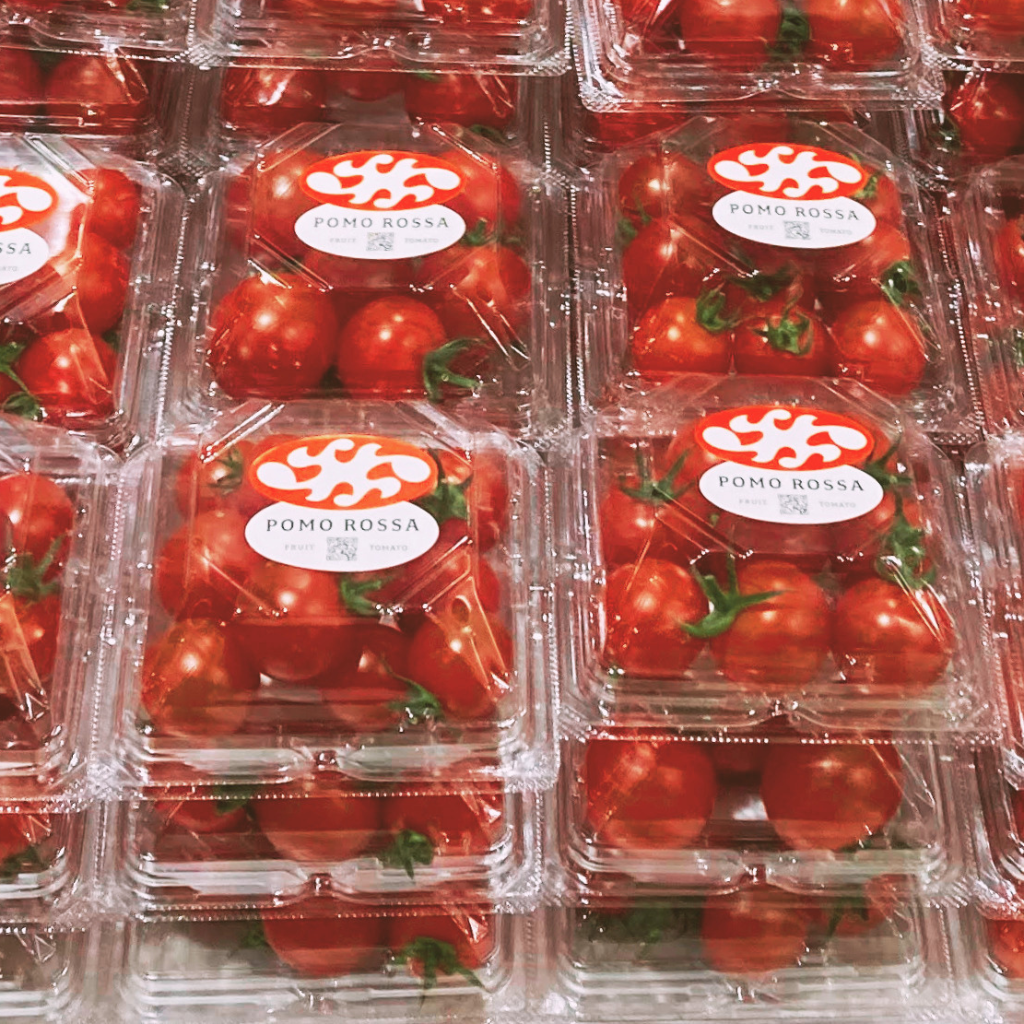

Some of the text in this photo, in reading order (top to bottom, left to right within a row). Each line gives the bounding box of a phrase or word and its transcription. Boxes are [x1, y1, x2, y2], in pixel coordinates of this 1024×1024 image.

[730, 204, 859, 221] POMO ROSSA
[314, 217, 449, 229] POMO ROSSA
[719, 476, 864, 492] POMO ROSSA
[267, 519, 419, 532] POMO ROSSA
